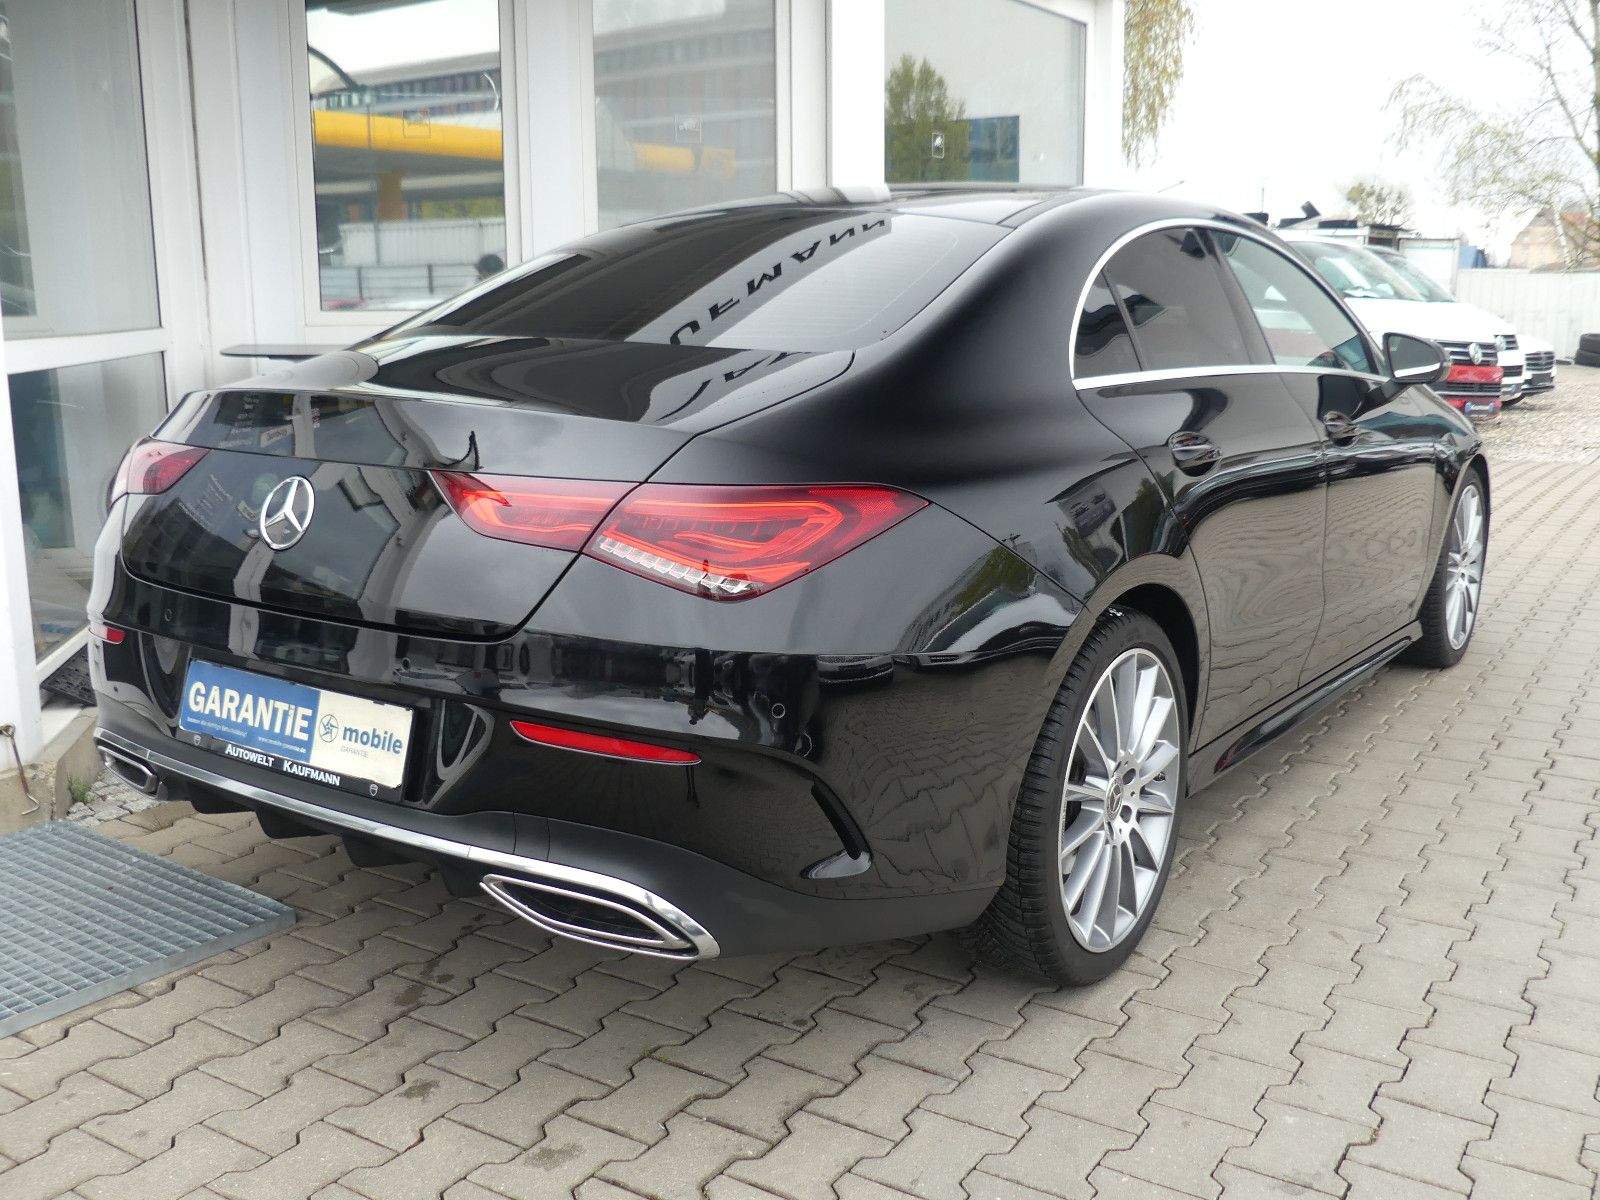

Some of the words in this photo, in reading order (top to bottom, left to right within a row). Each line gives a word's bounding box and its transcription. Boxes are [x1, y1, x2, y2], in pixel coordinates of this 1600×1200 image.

[342, 724, 403, 755] mobile
[224, 743, 275, 768] AUTOWELT
[282, 760, 341, 786] KAUFMANN
